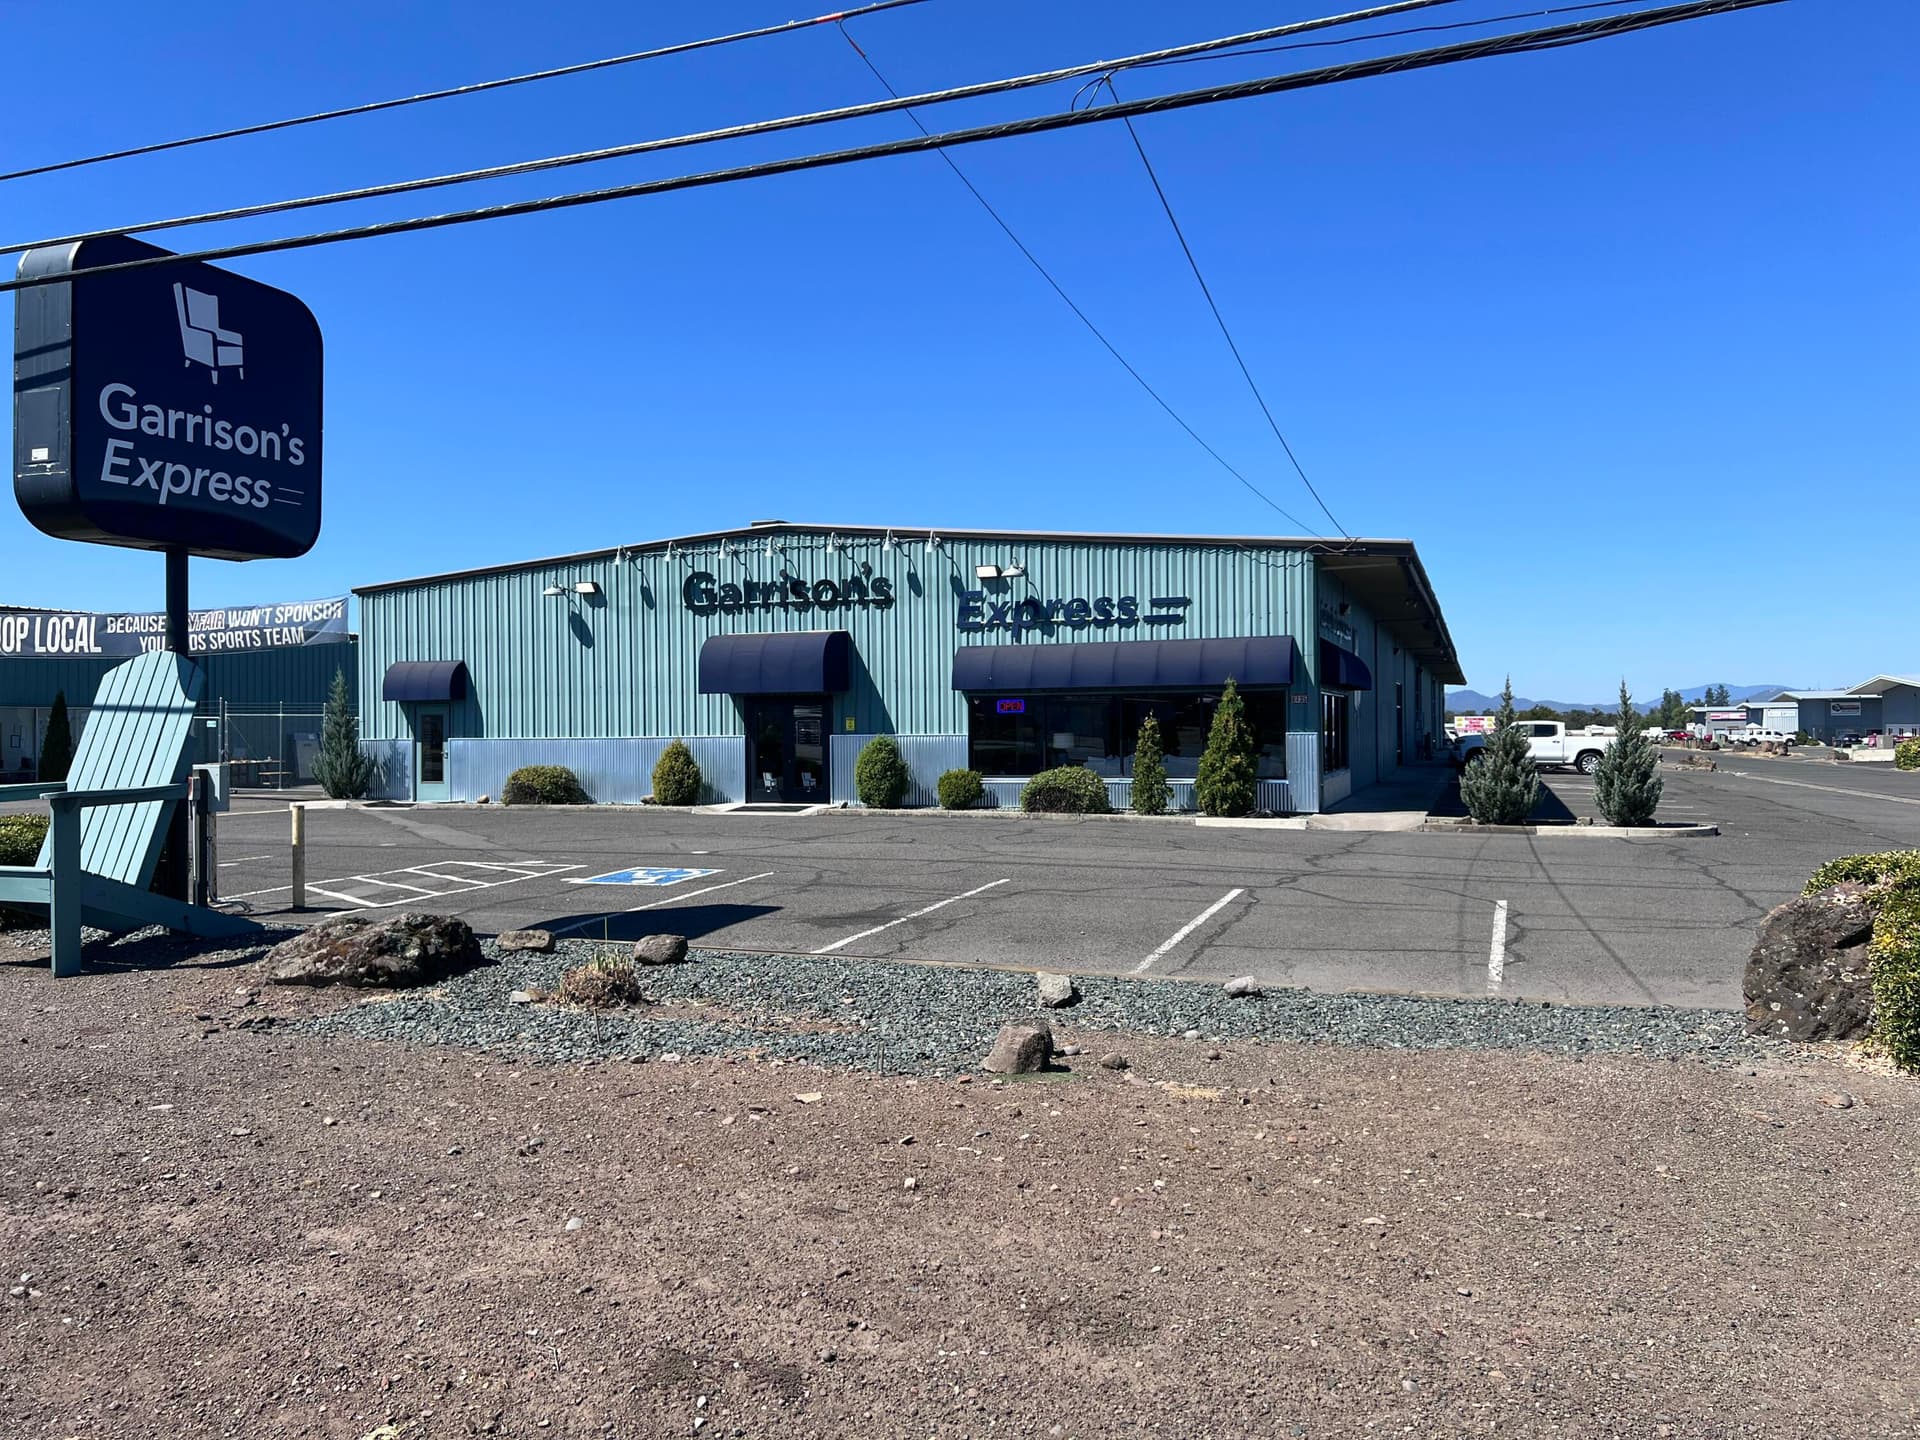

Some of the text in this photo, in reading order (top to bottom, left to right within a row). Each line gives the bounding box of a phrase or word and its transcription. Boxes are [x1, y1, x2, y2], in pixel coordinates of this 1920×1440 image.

[99, 382, 305, 466] Garrison's
[100, 438, 272, 508] Express
[683, 561, 893, 610] Garrison's
[0, 616, 102, 653] OP LOCAL
[106, 602, 343, 633] BECAUSE YFAIR WON'T SPONSOR
[957, 590, 1138, 643] Express
[139, 636, 166, 652] YOU
[210, 629, 259, 649] SPORTS
[265, 625, 305, 646] TEAM
[999, 702, 1022, 711] OPEN
